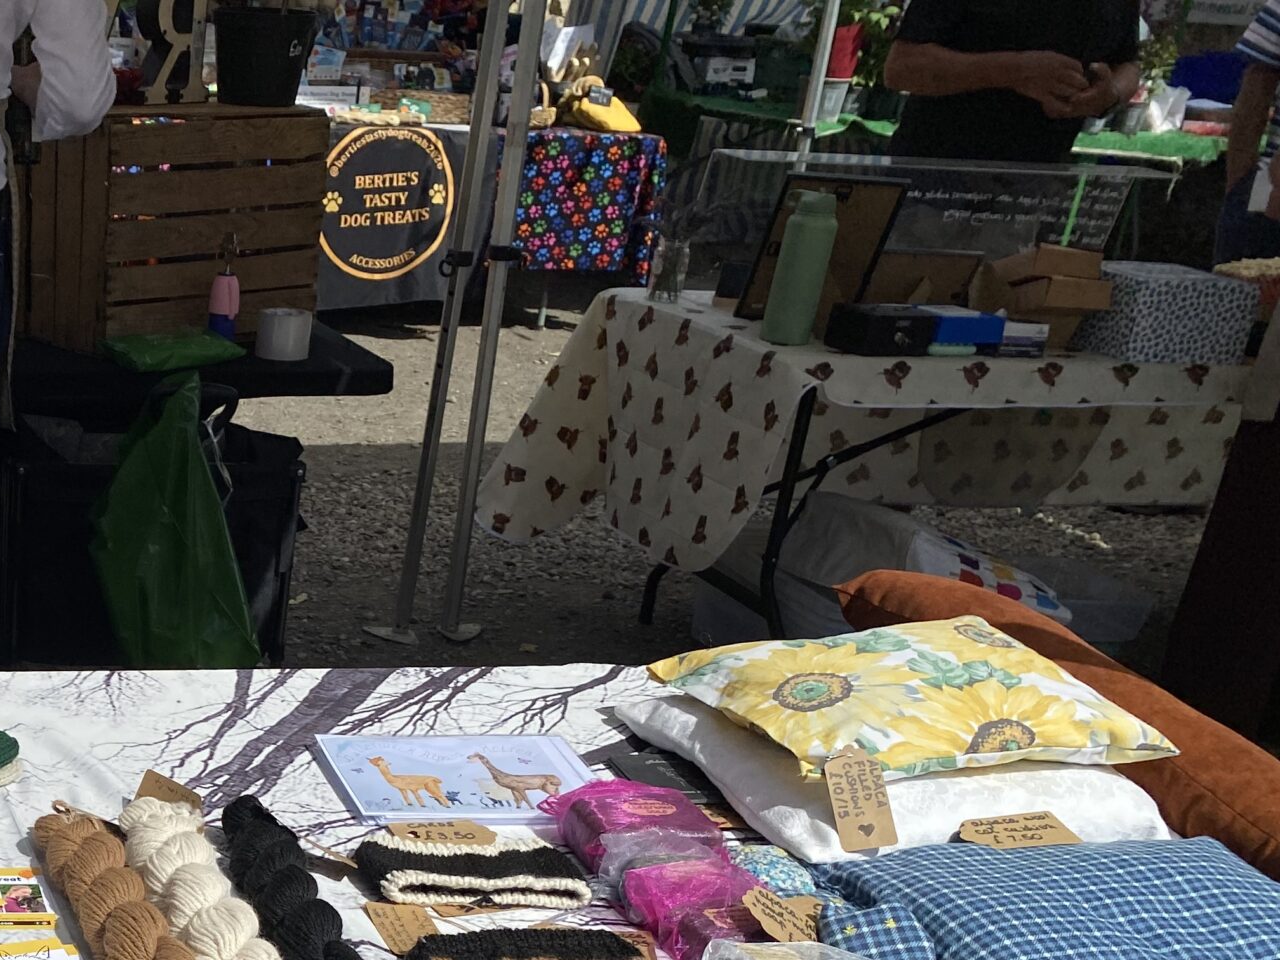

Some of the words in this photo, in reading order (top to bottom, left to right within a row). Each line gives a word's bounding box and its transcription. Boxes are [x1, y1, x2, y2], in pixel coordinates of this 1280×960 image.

[354, 171, 420, 190] BERTIE'S
[363, 191, 409, 209] TASTY
[340, 213, 371, 228] DOG
[374, 207, 431, 226] TREATS
[348, 247, 417, 269] ACCESSORIES
[842, 762, 865, 818] CUSHIONS
[854, 760, 873, 802] FILLED
[866, 759, 888, 808] ALPACA
[406, 821, 455, 829] CARDS
